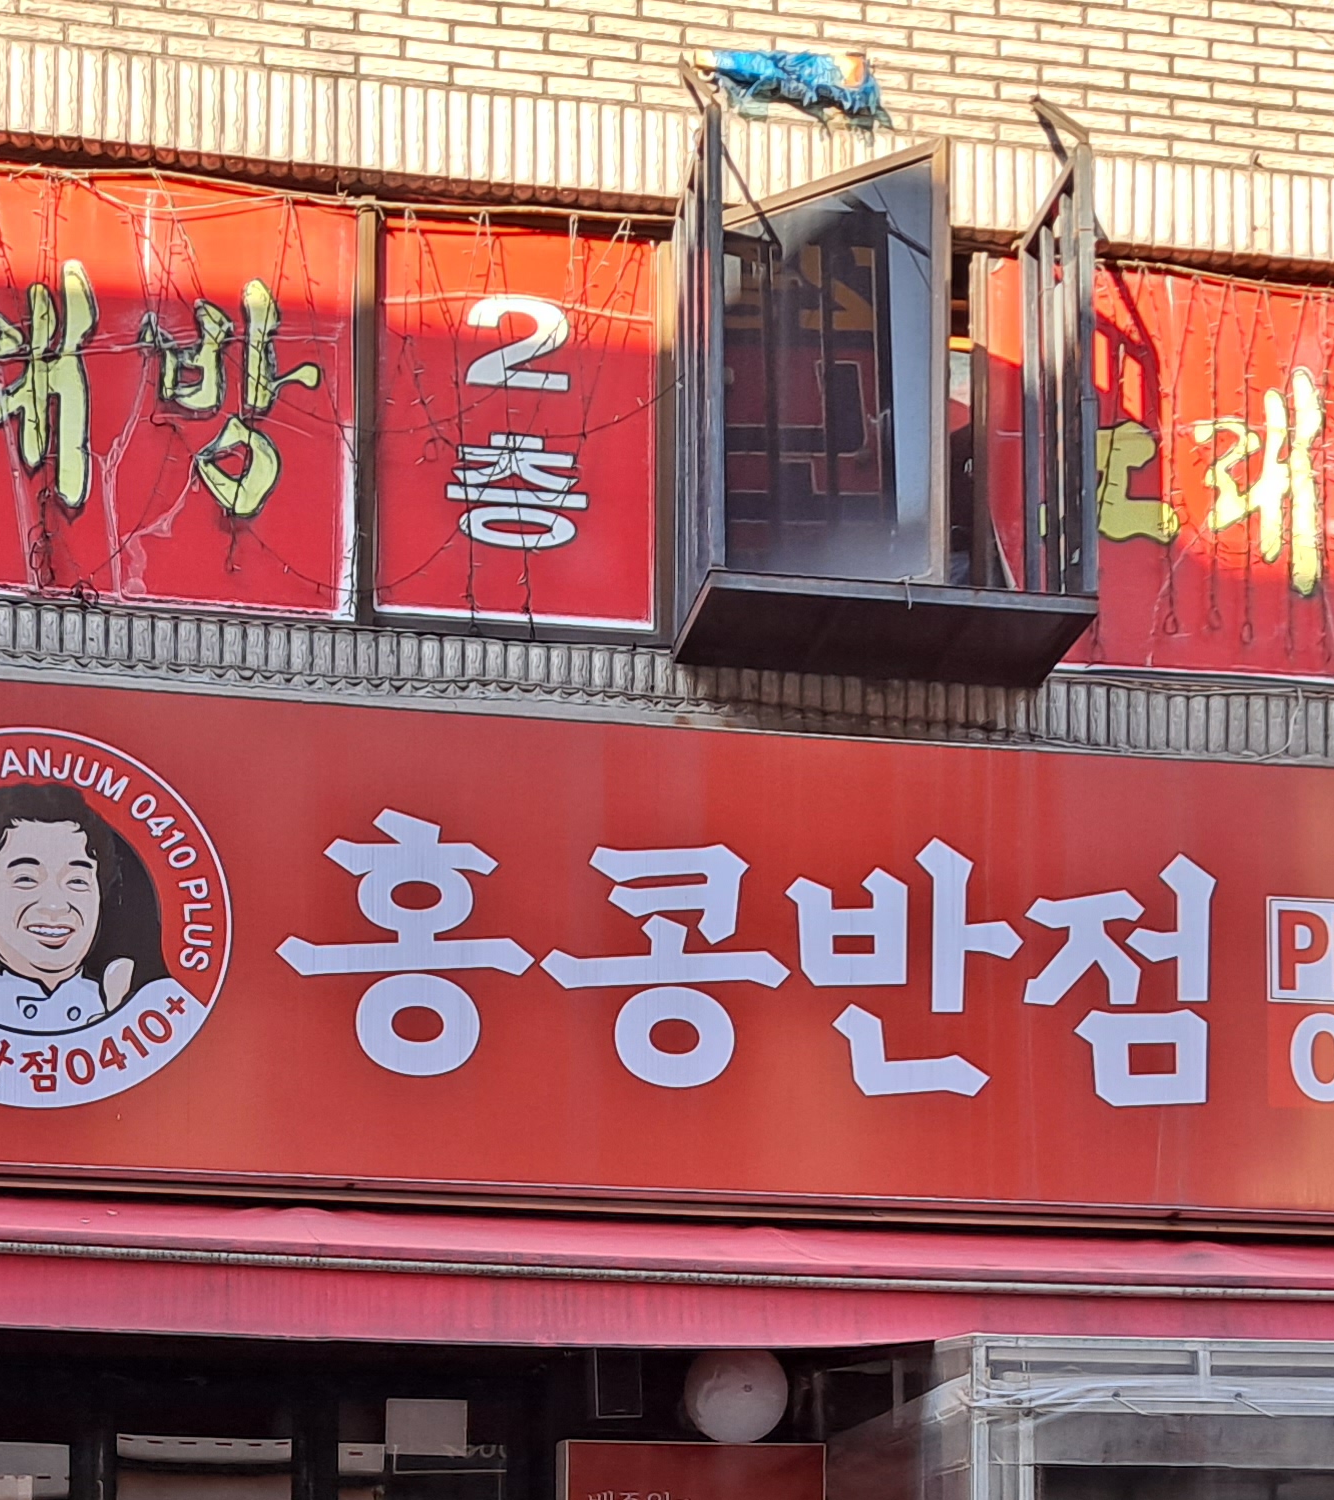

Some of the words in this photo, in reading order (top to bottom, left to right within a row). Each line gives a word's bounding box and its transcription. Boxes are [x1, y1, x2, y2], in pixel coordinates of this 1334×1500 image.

[445, 295, 590, 549] 2층
[130, 792, 200, 869] 0410
[178, 878, 216, 973] PLUS
[276, 808, 1216, 1107] 홍콩반점
